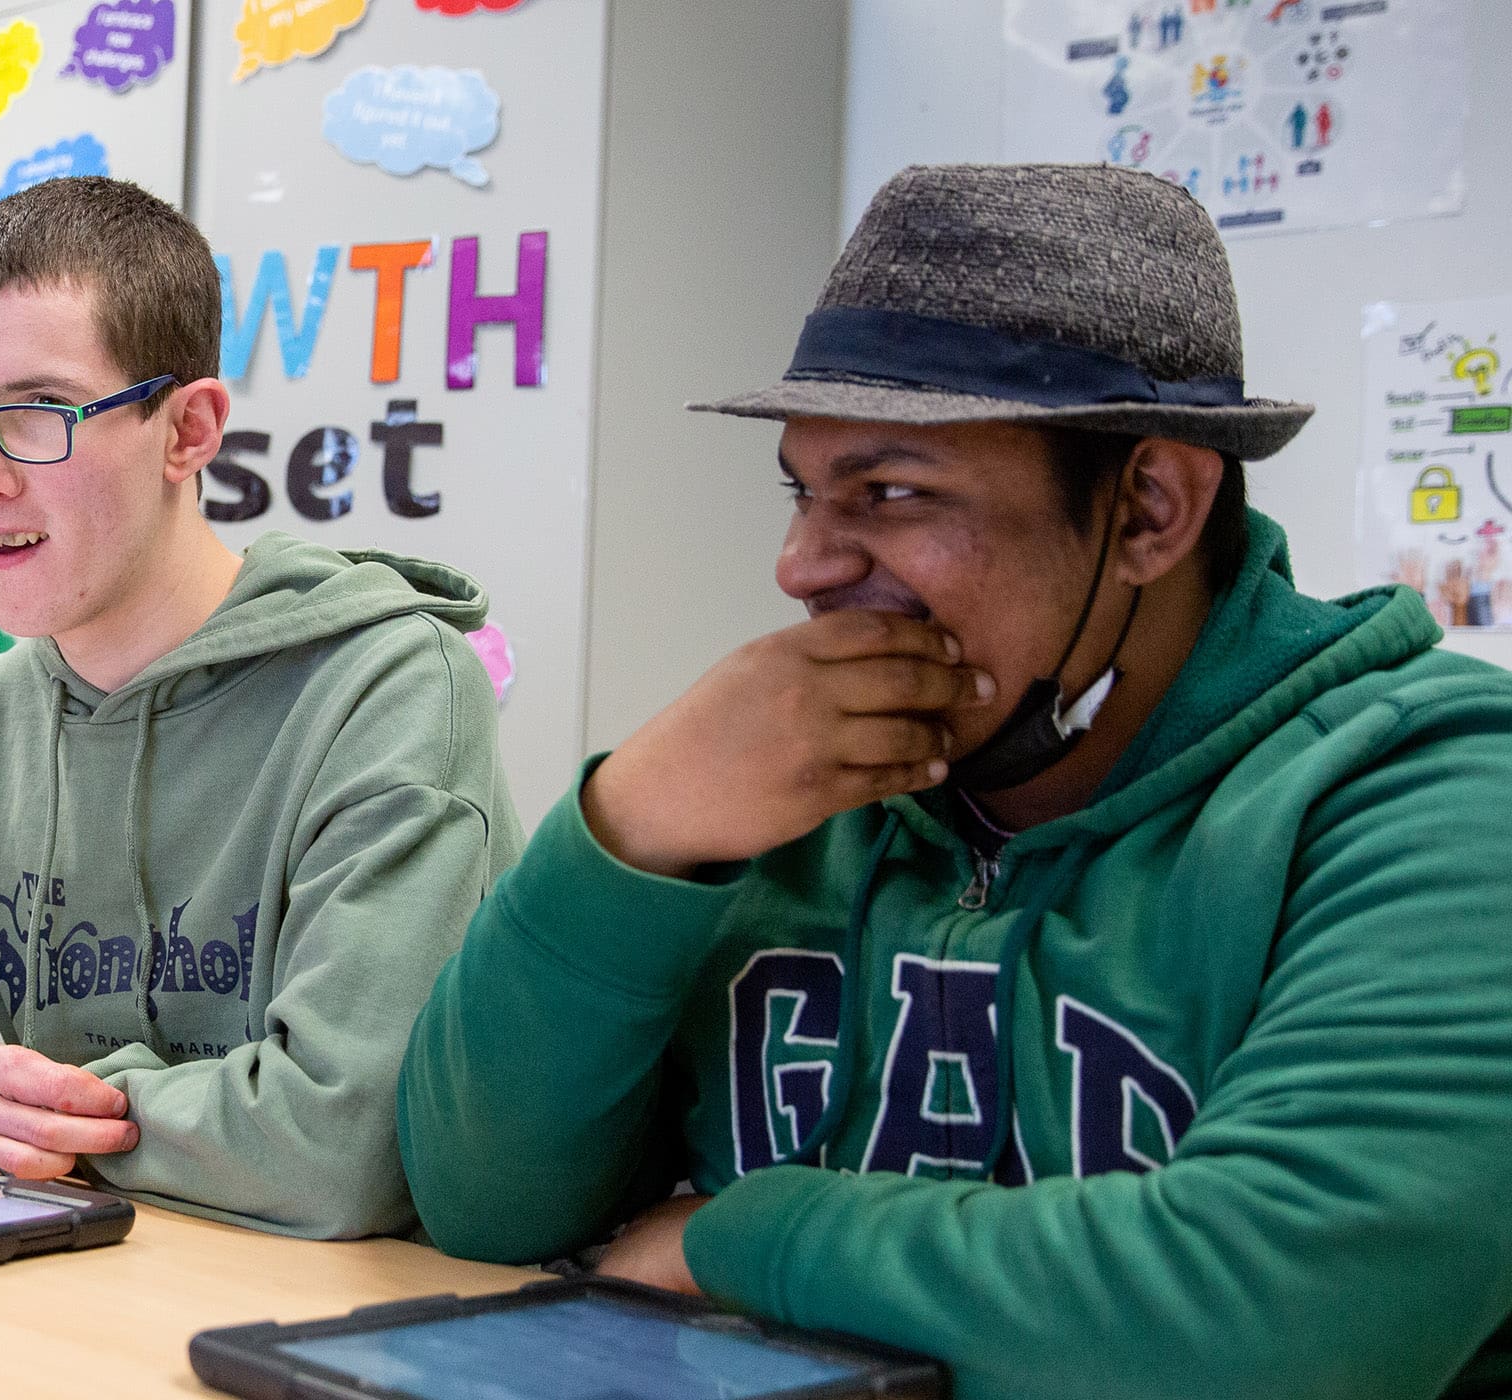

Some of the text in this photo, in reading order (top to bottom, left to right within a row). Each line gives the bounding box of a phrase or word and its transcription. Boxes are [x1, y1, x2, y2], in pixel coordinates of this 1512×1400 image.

[215, 231, 548, 391] WTH
[205, 398, 443, 523] set
[170, 1042, 229, 1057] MARK
[729, 947, 1198, 1186] GAP
